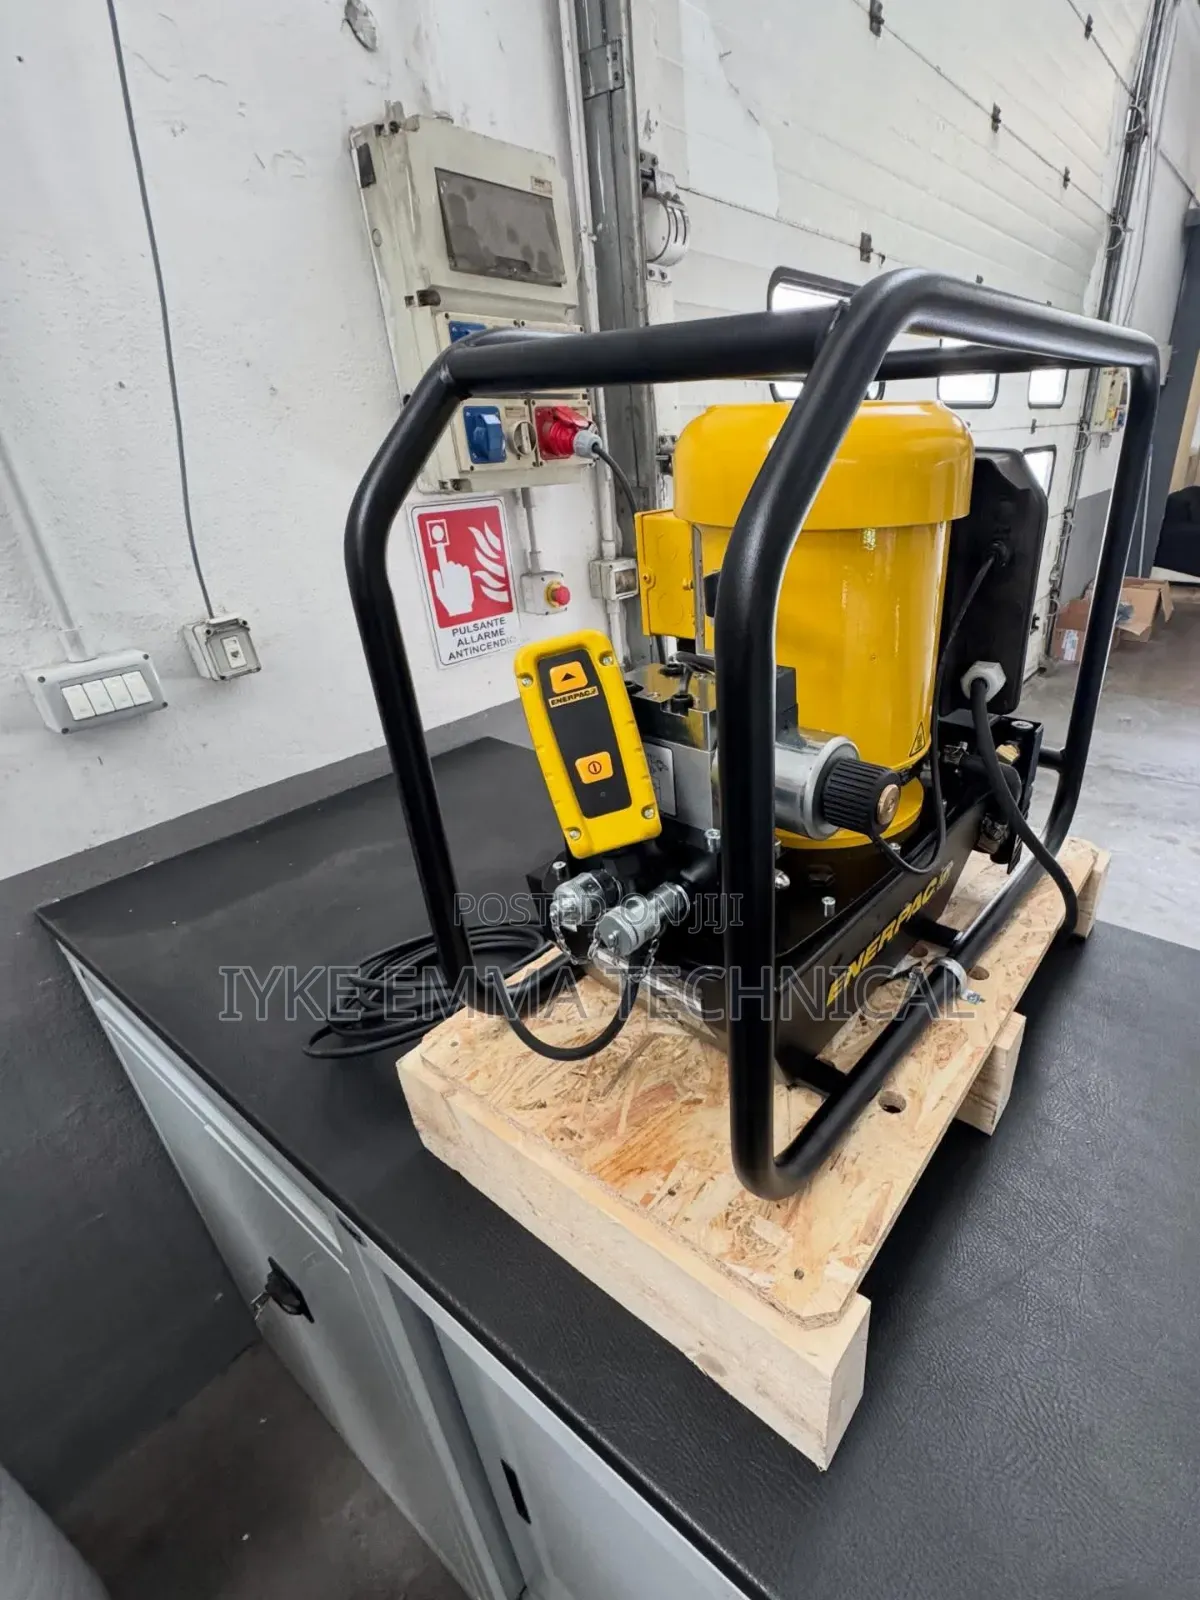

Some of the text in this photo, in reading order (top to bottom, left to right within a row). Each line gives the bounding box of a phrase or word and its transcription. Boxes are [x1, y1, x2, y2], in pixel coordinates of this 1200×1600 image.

[452, 616, 507, 637] PULSANTE
[457, 628, 505, 647] ALLARME
[550, 689, 591, 706] ENERPAC
[826, 876, 938, 1008] ENERPAC
